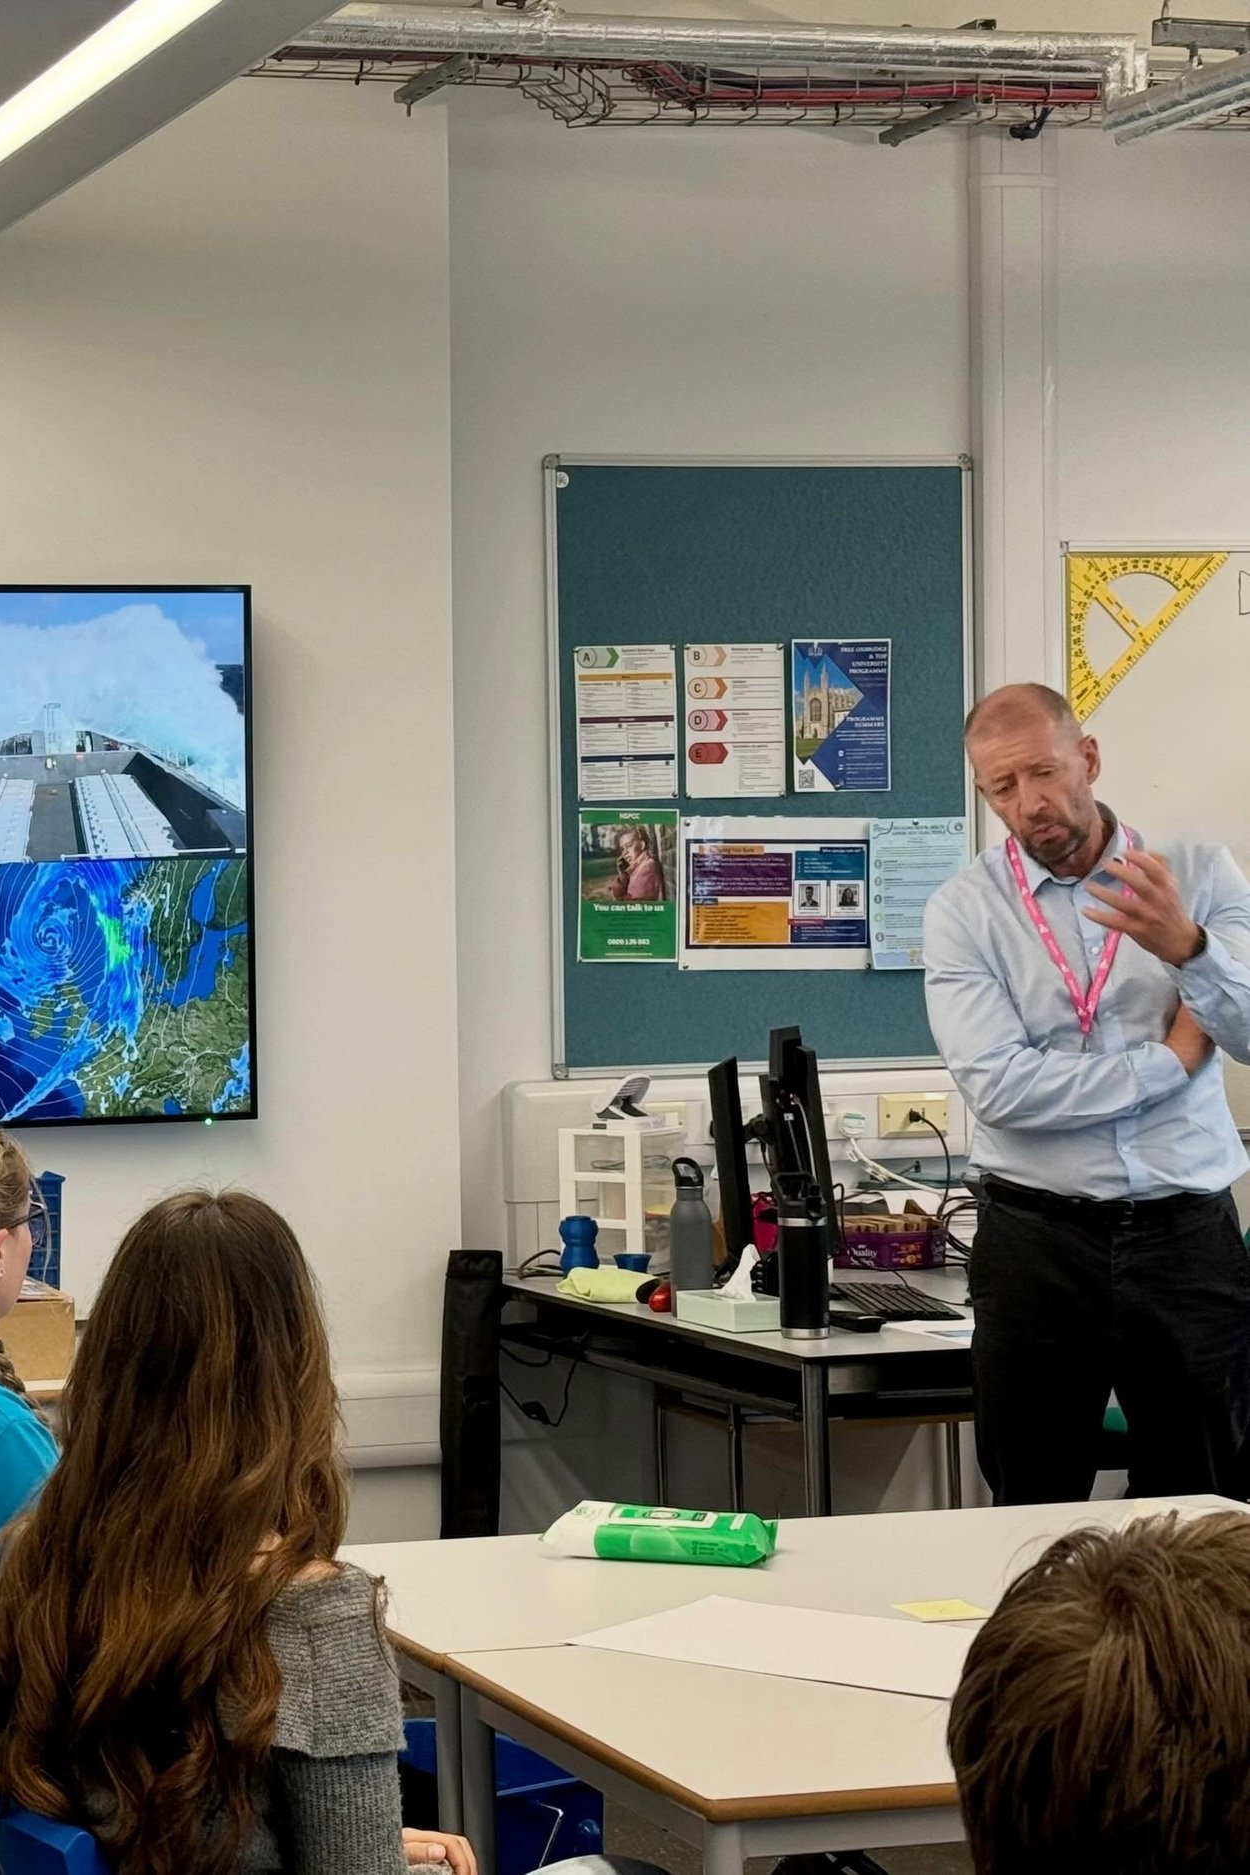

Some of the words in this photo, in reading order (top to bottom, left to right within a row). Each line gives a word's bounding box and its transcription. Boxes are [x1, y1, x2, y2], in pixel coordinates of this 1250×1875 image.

[582, 652, 591, 662] A
[693, 650, 701, 661] B
[693, 683, 702, 693] C
[693, 715, 702, 725] D
[694, 748, 702, 758] E
[619, 812, 640, 820] NSPCC
[593, 903, 609, 911] You
[626, 903, 643, 911] talk
